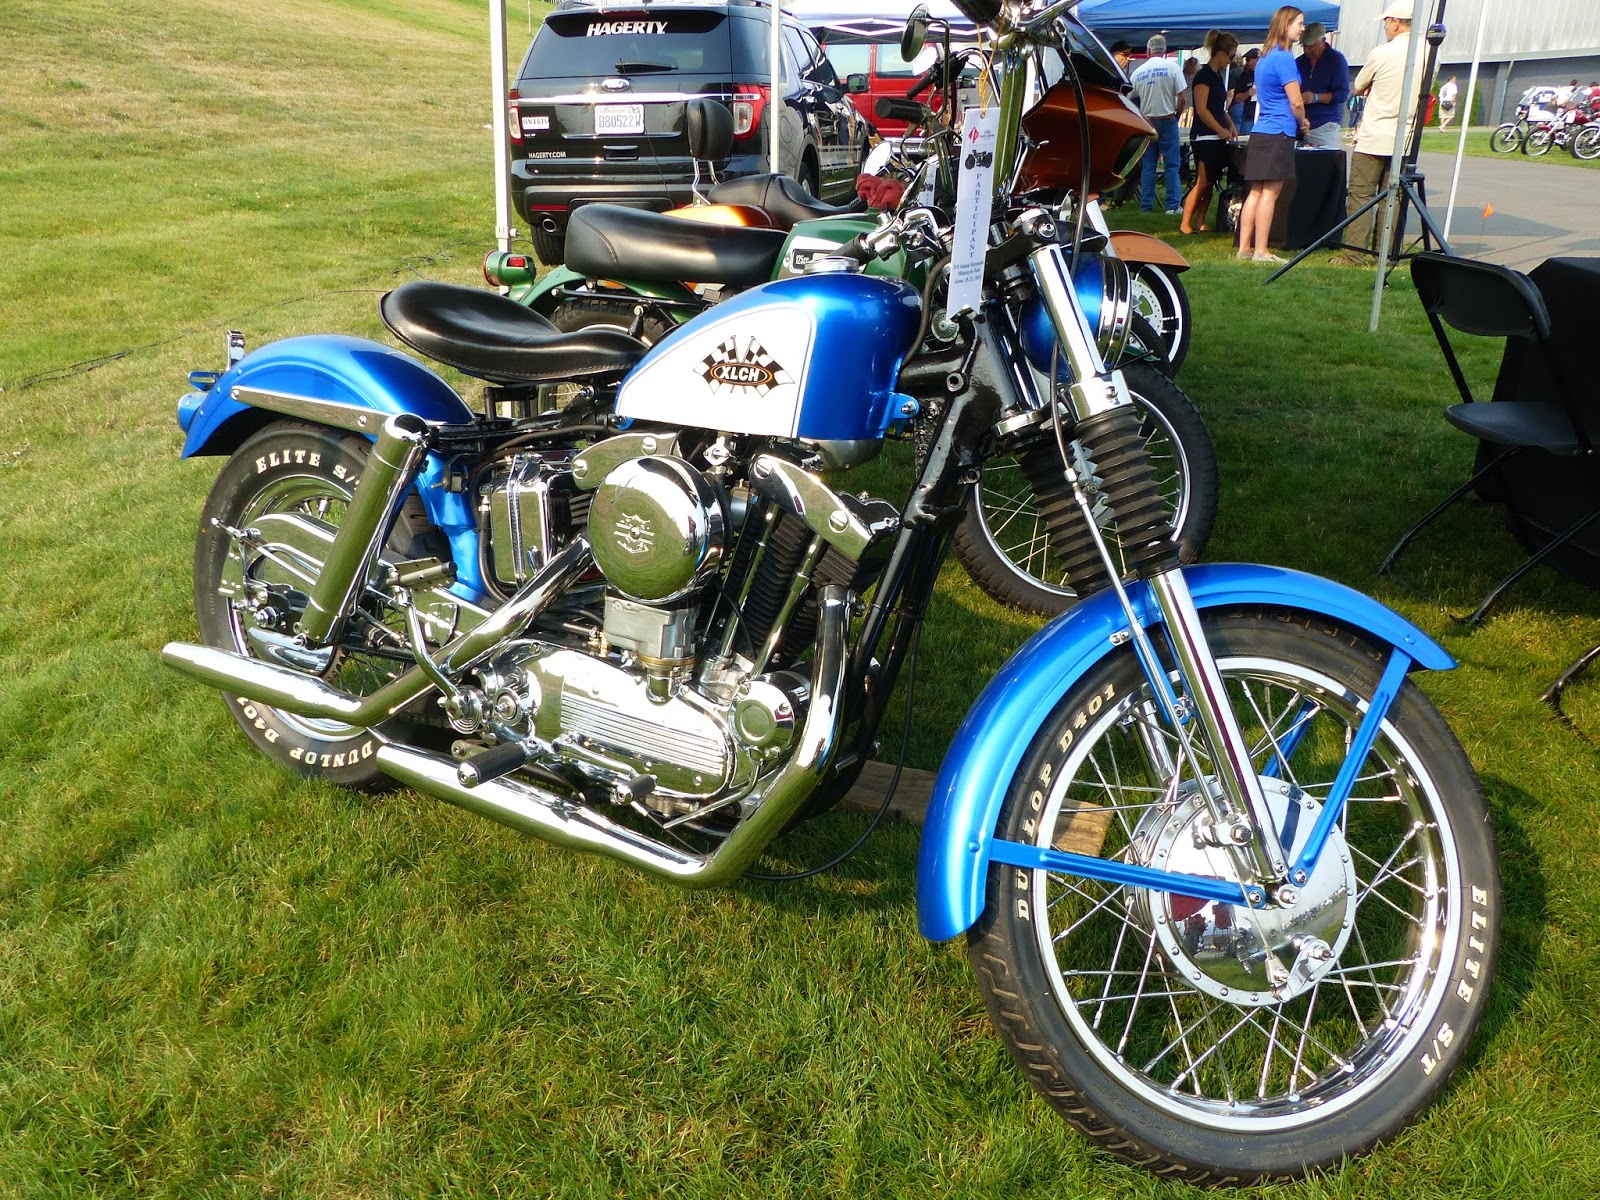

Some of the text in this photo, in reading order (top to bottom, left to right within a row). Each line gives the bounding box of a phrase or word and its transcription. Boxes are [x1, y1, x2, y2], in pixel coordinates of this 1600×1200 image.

[586, 21, 668, 37] HAGERTY
[599, 114, 641, 129] B80522W
[528, 151, 567, 159] HAGERTY.COM
[968, 173, 983, 258] PARTICIPANT
[719, 366, 760, 382] XLCH
[256, 449, 360, 491] ELITE S/
[289, 740, 373, 768] DUNLOP
[1015, 683, 1117, 922] DULOP D401
[1419, 884, 1488, 1076] ELITE S/T
